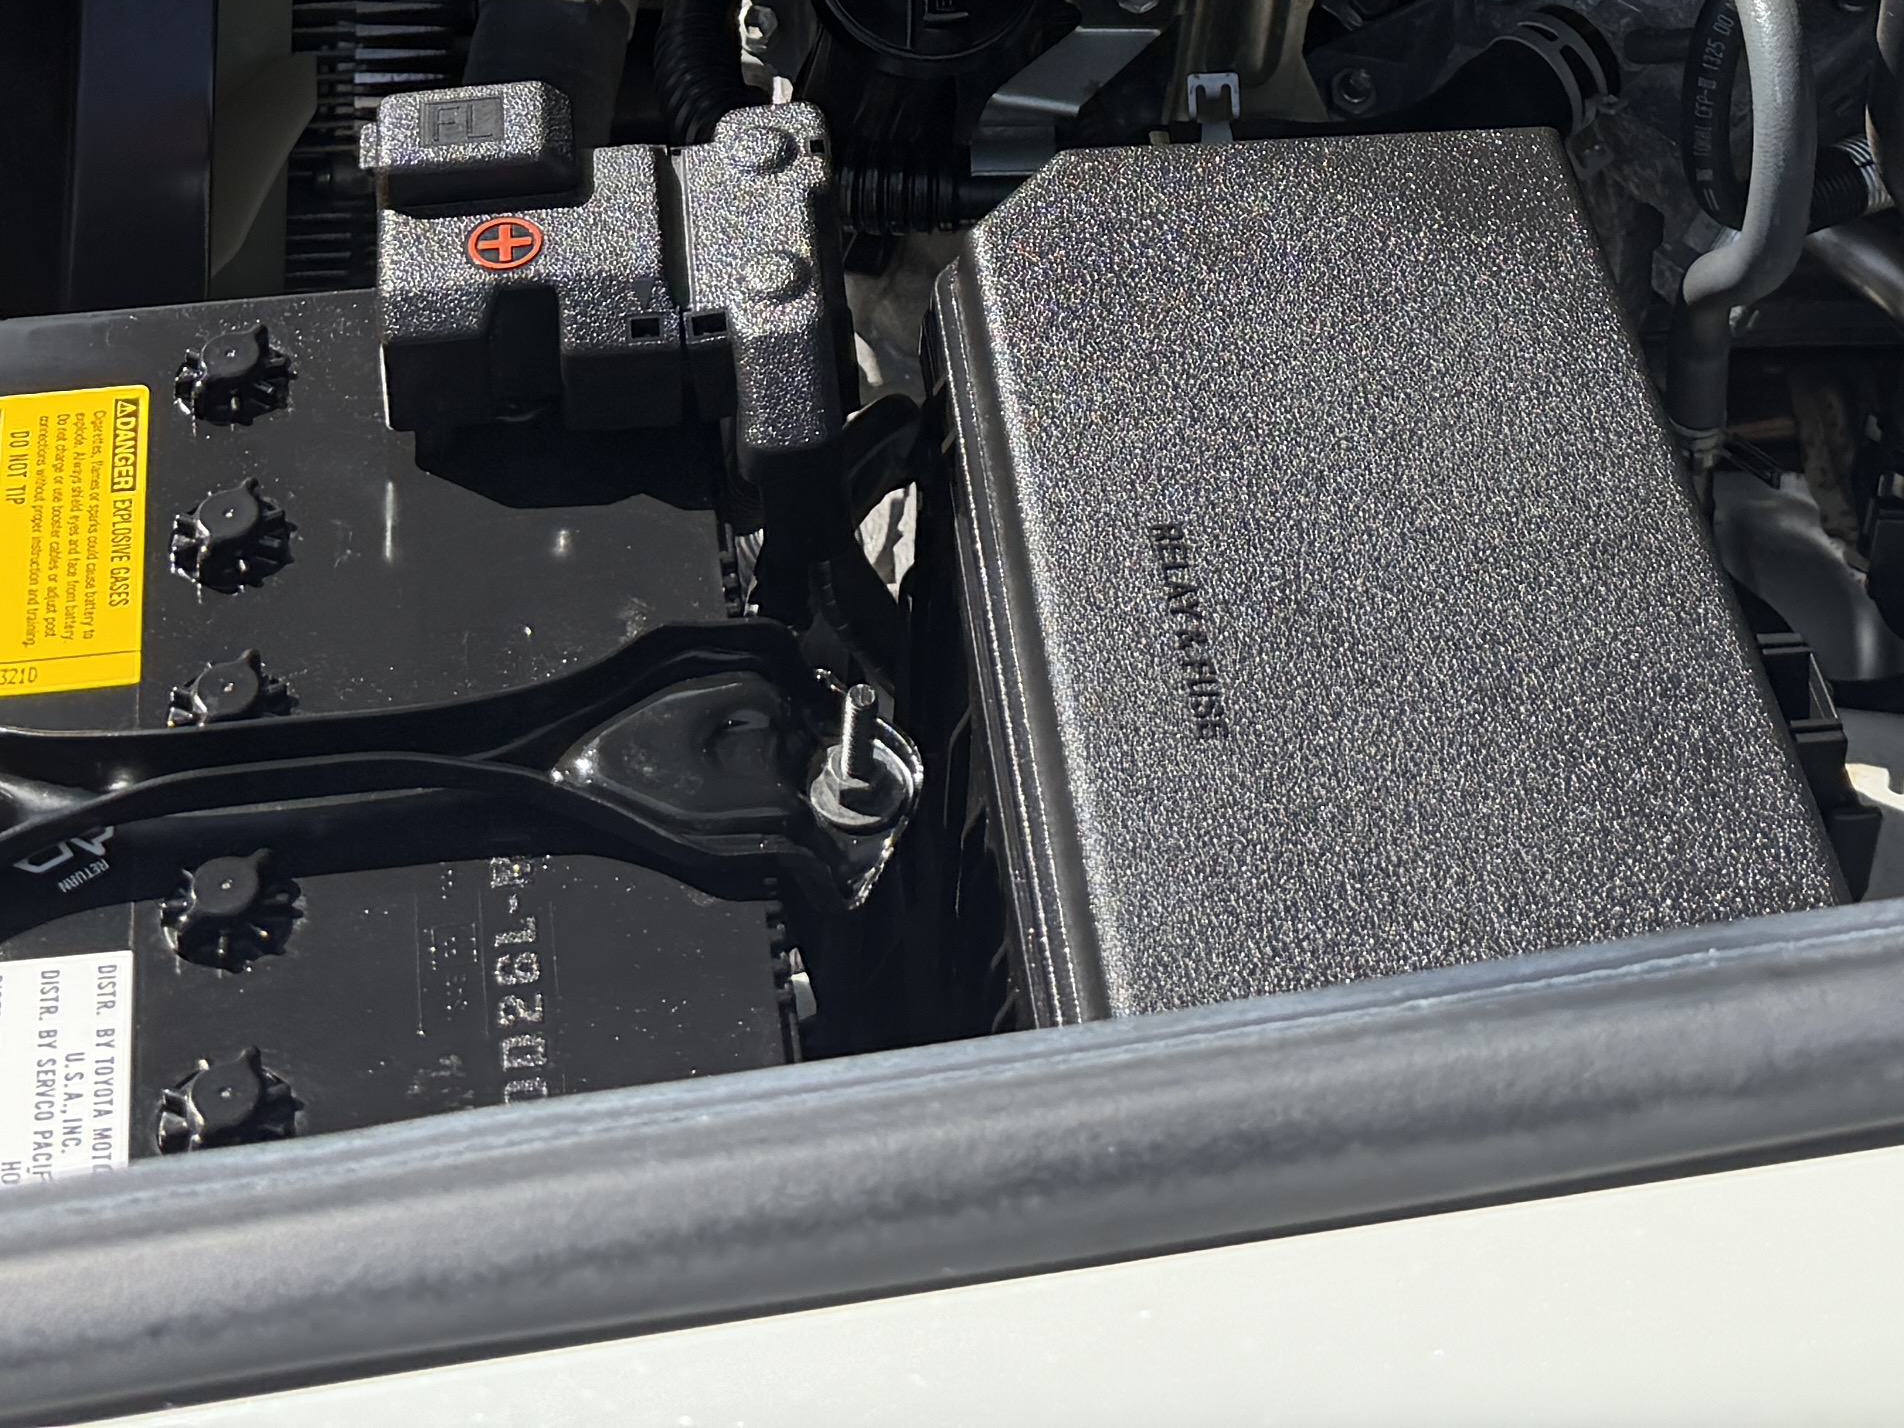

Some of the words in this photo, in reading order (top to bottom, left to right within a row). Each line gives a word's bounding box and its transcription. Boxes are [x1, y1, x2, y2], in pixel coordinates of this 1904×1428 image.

[1702, 38, 1726, 71] 1325
[434, 103, 493, 141] FL
[56, 427, 66, 441] not
[57, 414, 67, 425] Do
[70, 412, 87, 448] explode.
[89, 410, 106, 458] Cigarettes,
[9, 430, 29, 448] DO
[36, 415, 49, 465] connections
[111, 416, 136, 489] DANGER
[6, 453, 28, 478] NOT
[51, 444, 66, 473] charge
[69, 451, 84, 484] Always
[33, 468, 46, 502] without
[54, 475, 62, 484] or
[89, 460, 103, 490] flames
[5, 484, 26, 505] TIP
[53, 487, 62, 502] use
[70, 486, 82, 511] shield
[89, 491, 99, 501] or
[29, 504, 42, 533] proper
[50, 505, 62, 538] booster
[66, 515, 79, 535] eyes
[85, 504, 100, 533] sparks
[110, 498, 132, 562] EXPLOSIVE
[48, 541, 60, 570] cables
[68, 538, 79, 554] and
[86, 535, 99, 559] could
[28, 537, 42, 585] instruction
[67, 557, 79, 577] face
[85, 562, 96, 589] cause
[1150, 523, 1203, 620] RELAY
[48, 574, 57, 583] or
[66, 580, 77, 602] from
[108, 566, 130, 607] GASES
[27, 588, 39, 605] and
[43, 585, 58, 613] adjust
[80, 591, 97, 626] battery
[21, 608, 37, 648] training.
[42, 616, 55, 637] post
[60, 605, 76, 644] battery.
[82, 630, 94, 639] to
[1175, 630, 1208, 651] &
[1183, 661, 1229, 740] FUSE
[57, 858, 110, 893] RETURN
[38, 969, 60, 1020] DISTR.
[95, 964, 116, 1015] DISTR.
[36, 1028, 57, 1051] BY
[94, 1027, 115, 1050] BY
[33, 1057, 56, 1122] SERVCO
[92, 1056, 114, 1118] TOYOTA
